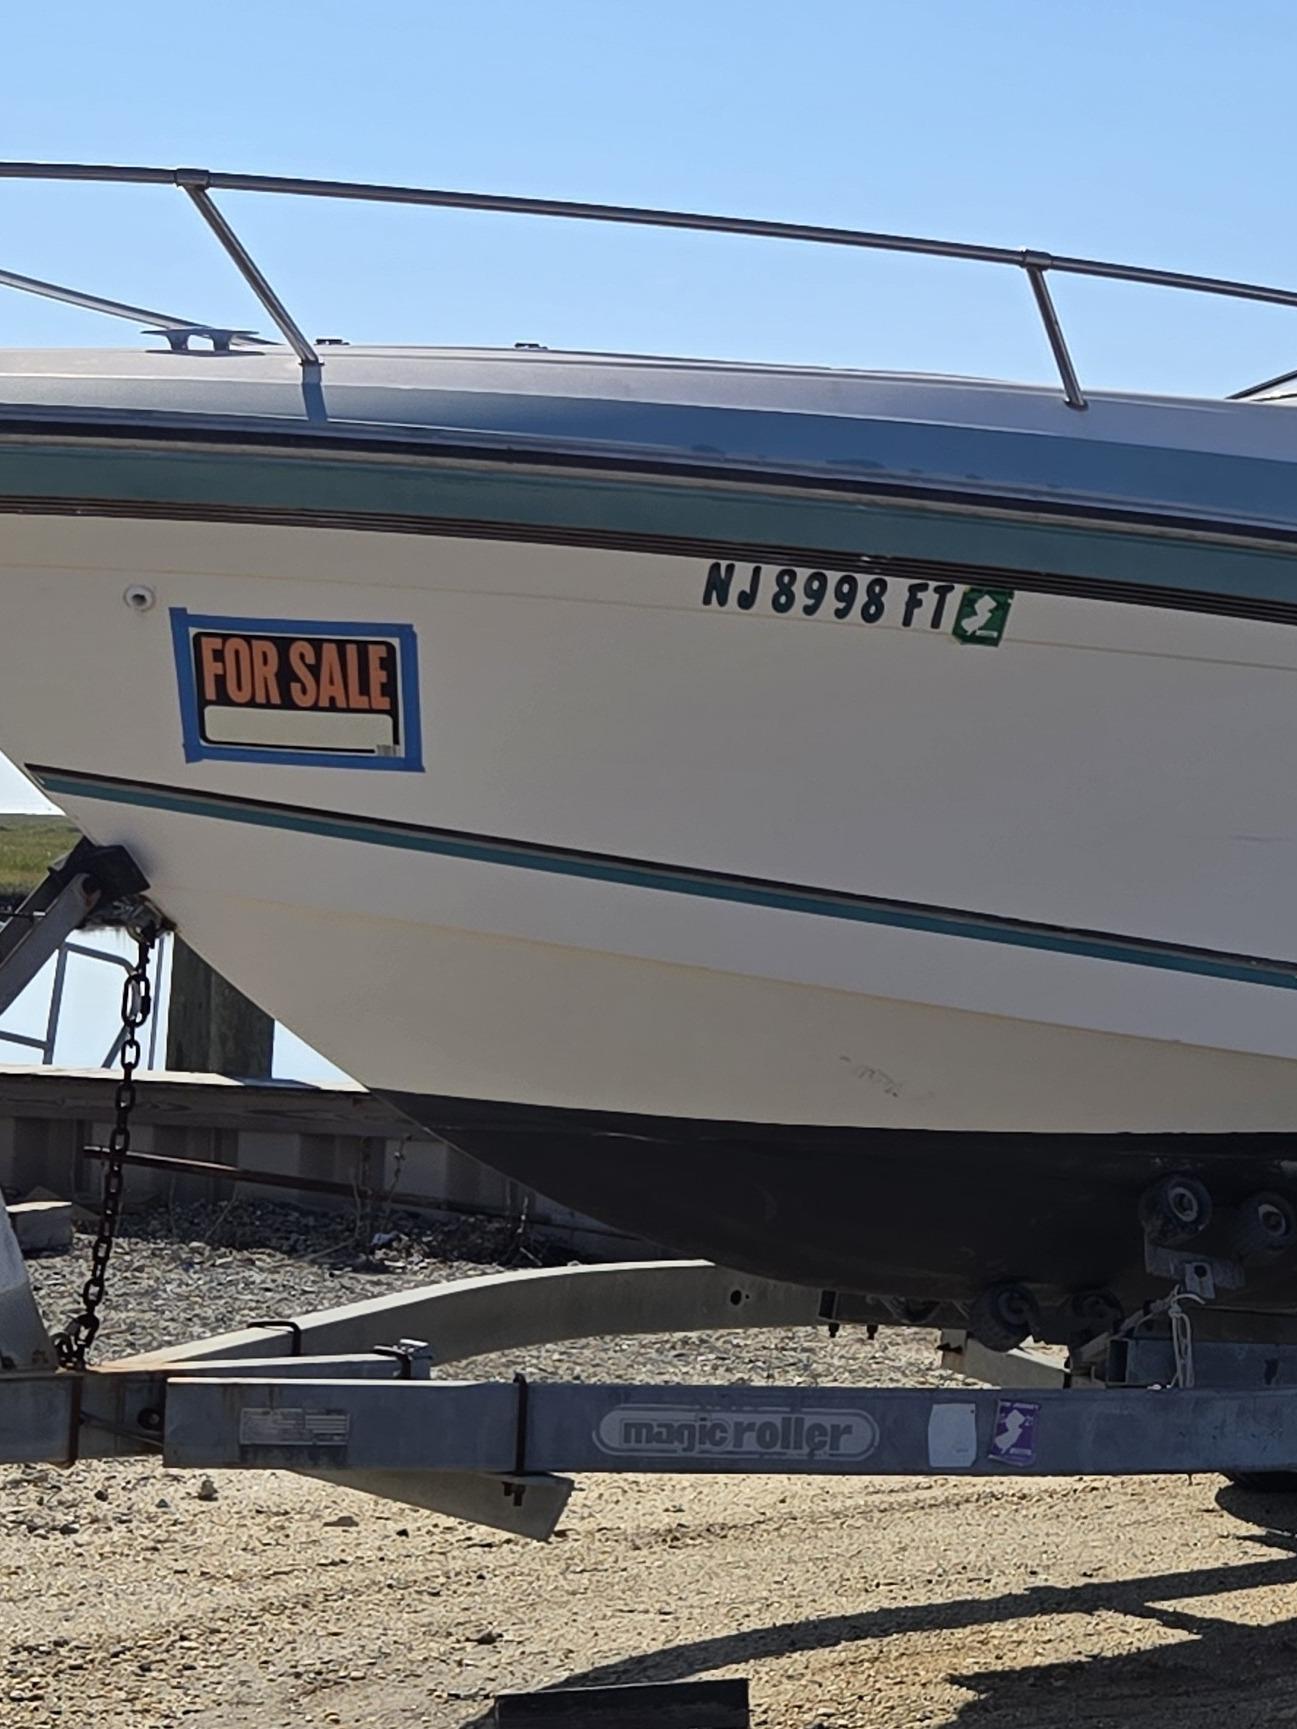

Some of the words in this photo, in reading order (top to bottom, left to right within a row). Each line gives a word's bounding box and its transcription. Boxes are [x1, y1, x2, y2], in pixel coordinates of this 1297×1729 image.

[702, 561, 762, 611] NJ
[771, 568, 888, 624] 8998
[901, 581, 955, 630] FT
[201, 636, 281, 704] FOR
[289, 640, 391, 710] SALE
